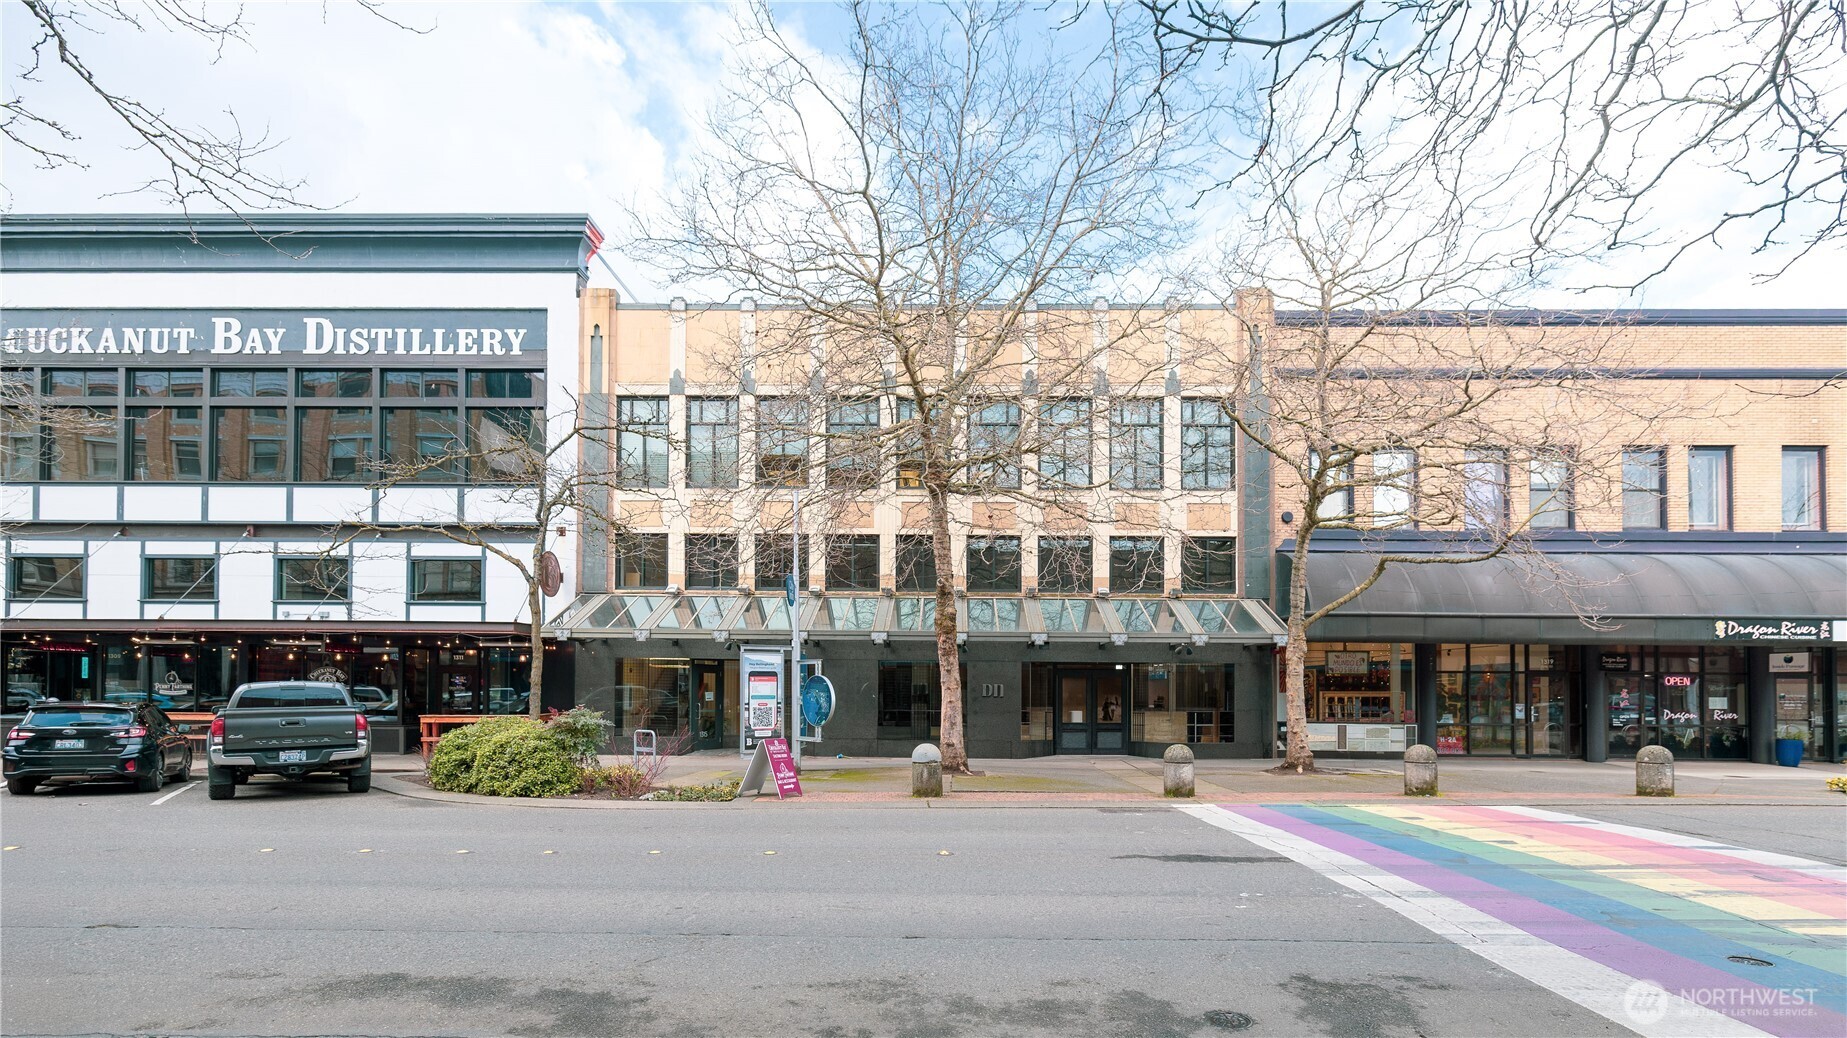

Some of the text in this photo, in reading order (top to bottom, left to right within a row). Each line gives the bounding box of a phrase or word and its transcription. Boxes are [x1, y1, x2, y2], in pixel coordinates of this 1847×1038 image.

[303, 317, 527, 355] DISTILLERY
[1727, 621, 1818, 639] Dragon River
[1665, 676, 1690, 686] OPEN
[1663, 708, 1739, 723] Dragon River
